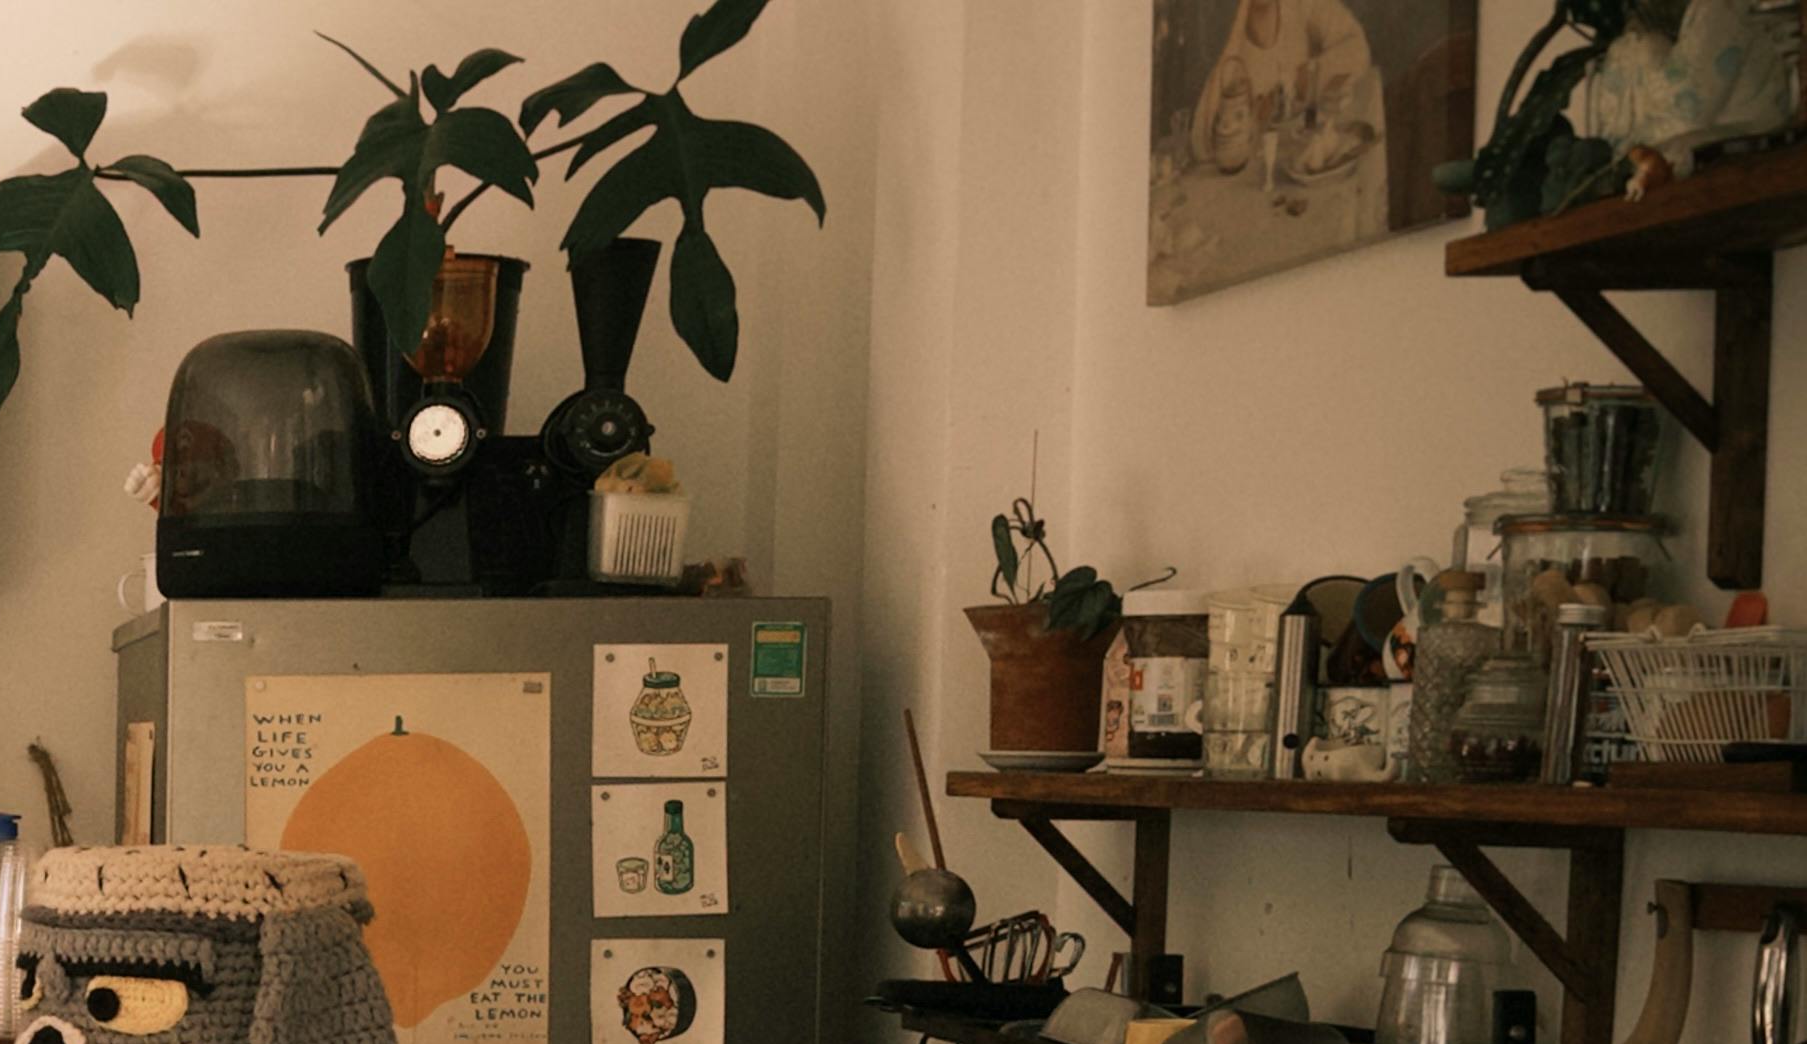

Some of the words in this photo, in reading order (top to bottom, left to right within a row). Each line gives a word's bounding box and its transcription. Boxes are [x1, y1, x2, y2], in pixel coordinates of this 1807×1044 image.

[252, 713, 321, 725] WHEN
[257, 730, 307, 745] LIFE
[252, 745, 313, 759] GIVES
[253, 762, 286, 773] YOU
[295, 763, 309, 774] A
[249, 775, 310, 788] LEMON
[500, 964, 539, 975] YOU
[489, 978, 544, 989] MUST
[470, 992, 501, 1004] EAT
[514, 992, 546, 1004] THE
[474, 1008, 542, 1020] LEMON
